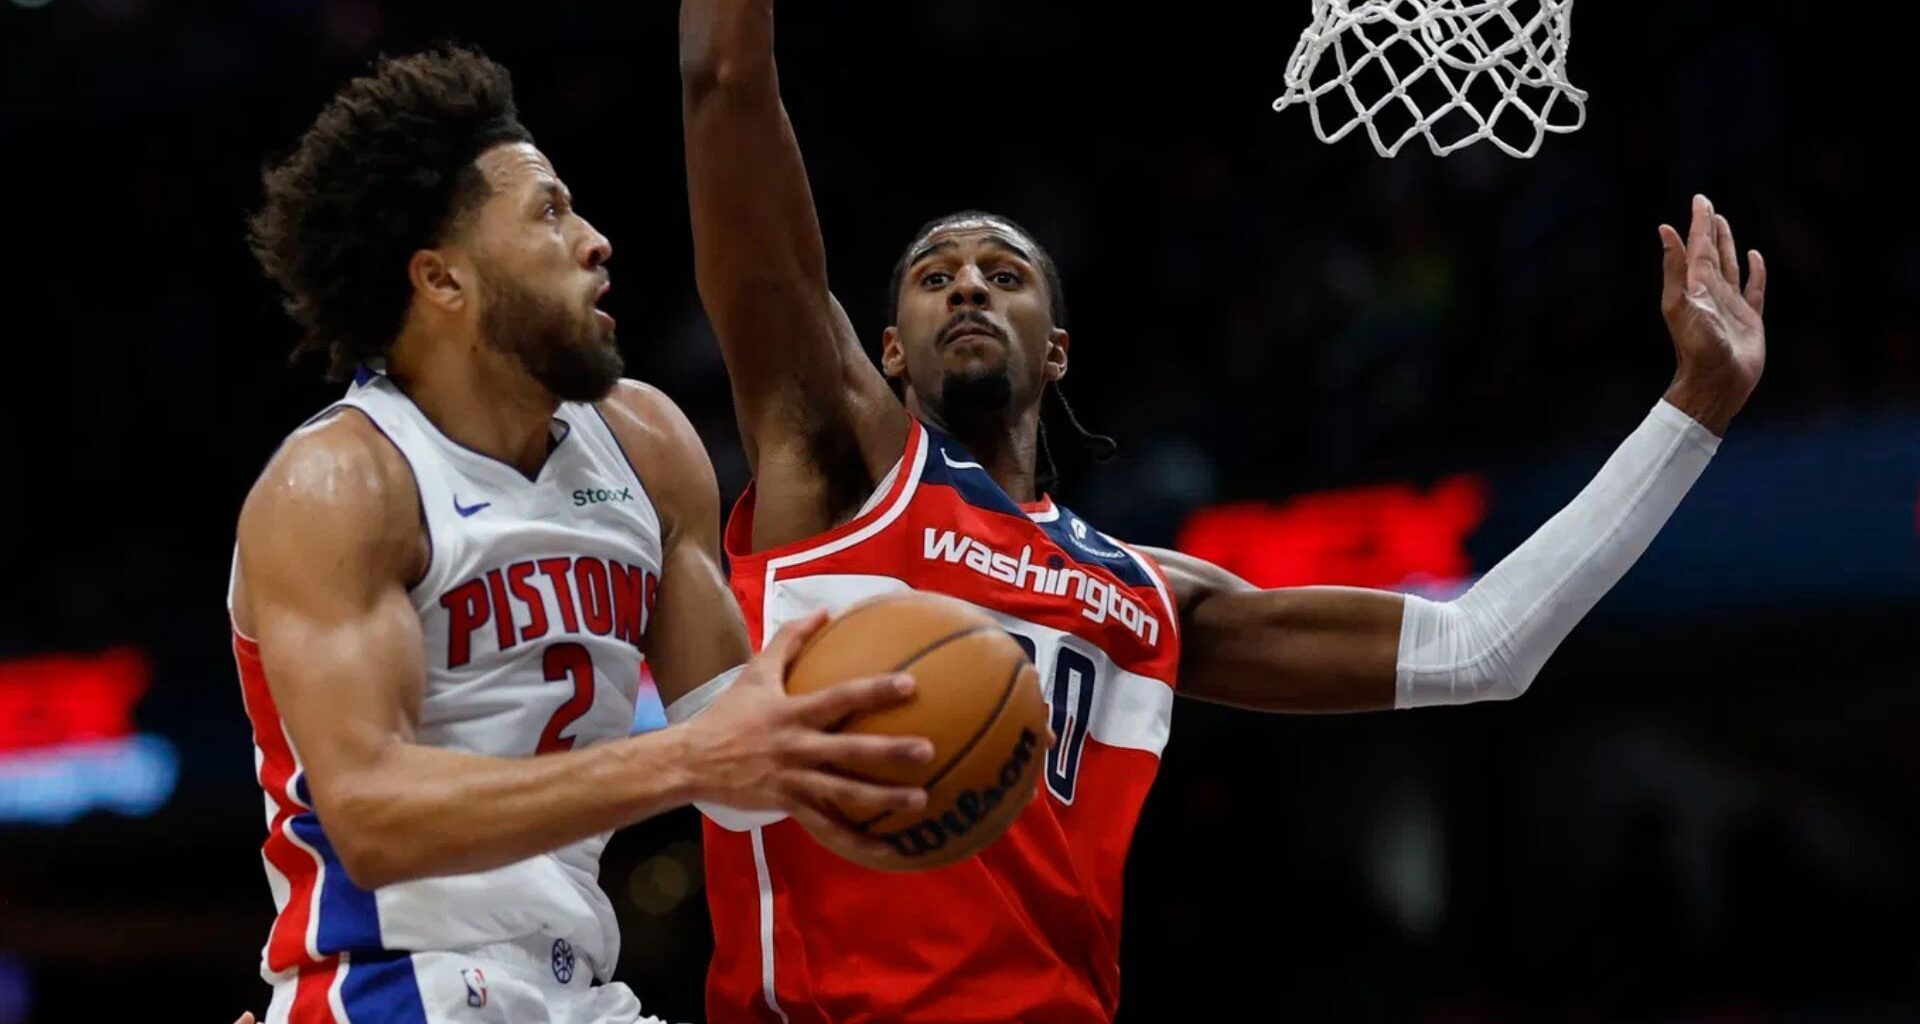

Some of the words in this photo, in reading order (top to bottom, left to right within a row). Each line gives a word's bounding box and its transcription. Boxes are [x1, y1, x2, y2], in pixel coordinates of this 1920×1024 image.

[923, 527, 1160, 647] Washington
[534, 642, 595, 756] 2
[1003, 630, 1096, 806] 0
[886, 727, 1037, 857] Wilson
